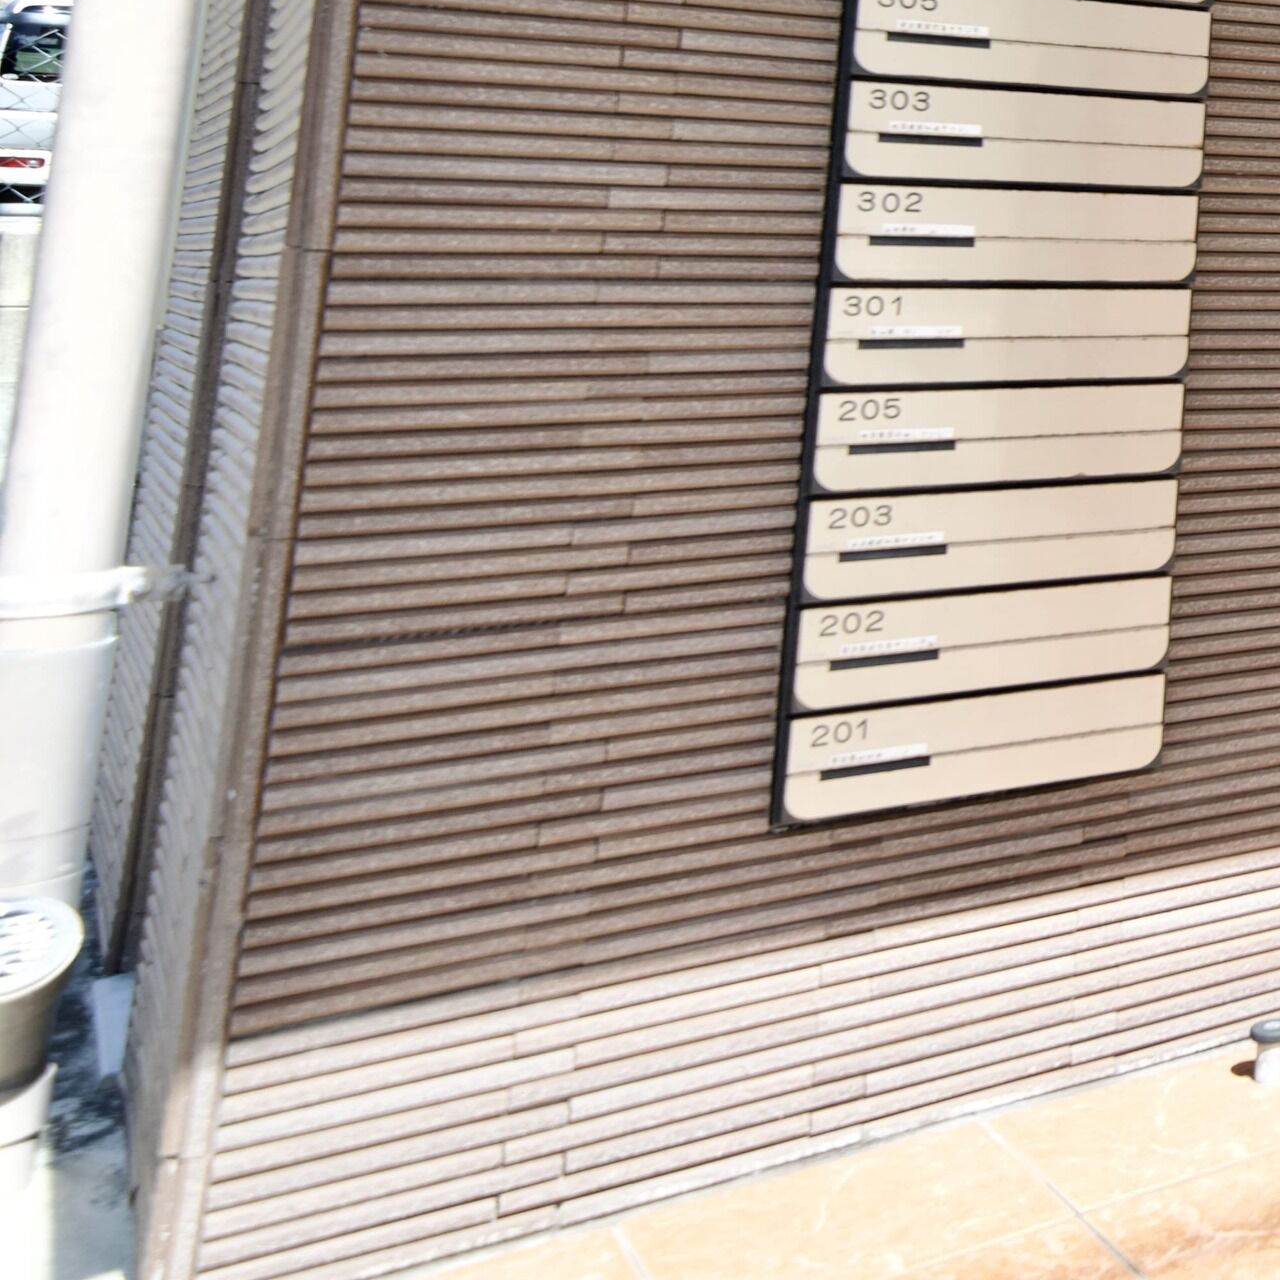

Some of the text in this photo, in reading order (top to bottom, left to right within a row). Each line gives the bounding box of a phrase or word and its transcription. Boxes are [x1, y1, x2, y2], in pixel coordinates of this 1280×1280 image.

[868, 89, 931, 112] 303
[857, 192, 923, 214] 302
[843, 296, 904, 317] 301
[838, 398, 902, 422] 205
[828, 505, 893, 529] 203
[819, 610, 885, 637] 202
[810, 719, 869, 747] 201
